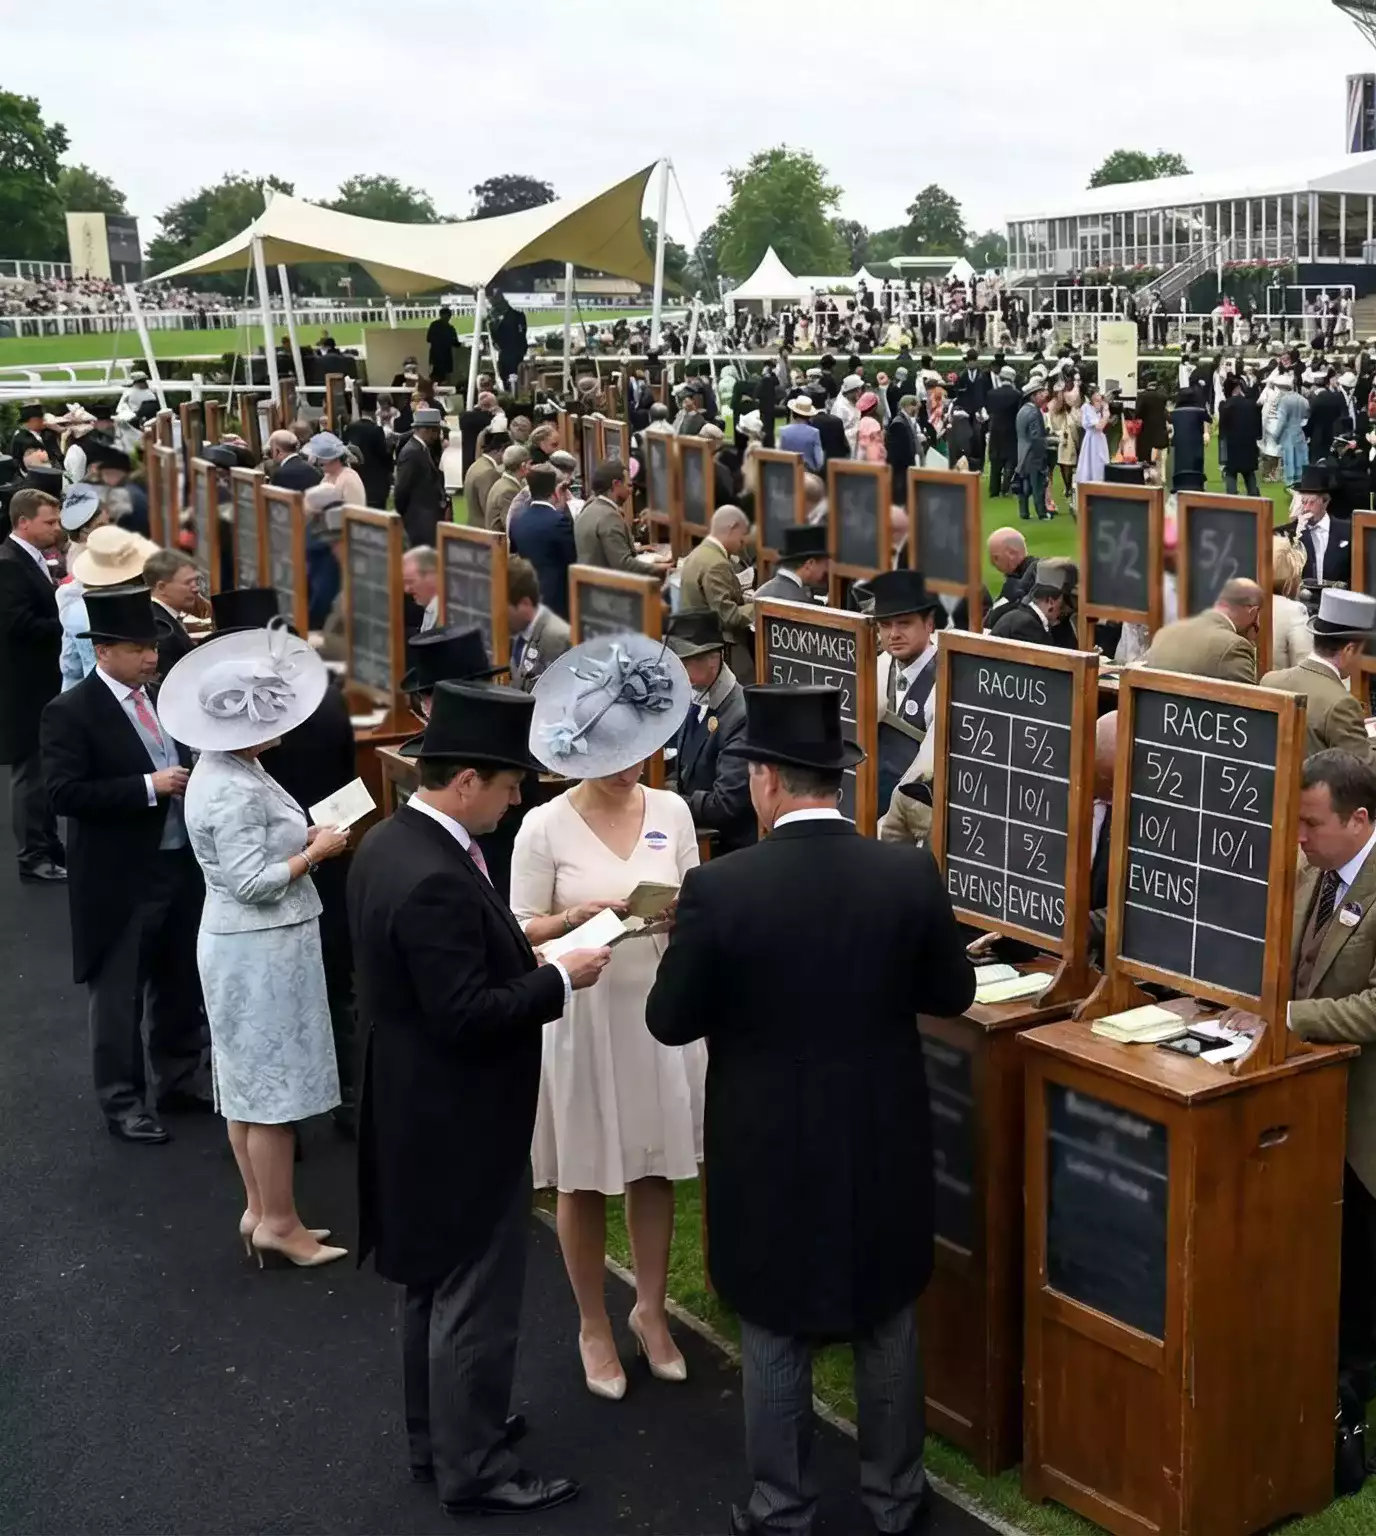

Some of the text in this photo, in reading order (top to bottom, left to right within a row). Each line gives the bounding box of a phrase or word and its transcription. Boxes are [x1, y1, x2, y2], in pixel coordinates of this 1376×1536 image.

[1097, 520, 1141, 580] 5/2
[771, 624, 856, 663] BOOKMAKER
[773, 665, 800, 684] 5/
[978, 668, 1047, 706] RACULS
[959, 715, 1054, 769] 5/2 5/2
[1163, 702, 1248, 748] RACES
[958, 769, 1050, 821] 10/1 10/1
[1146, 752, 1259, 813] 5/2 5/2
[962, 816, 1048, 874] 5/2 5/2
[1139, 812, 1253, 869] 10/1 10/1
[948, 868, 1065, 926] EVENS EVENS
[1129, 863, 1194, 906] EVENS
